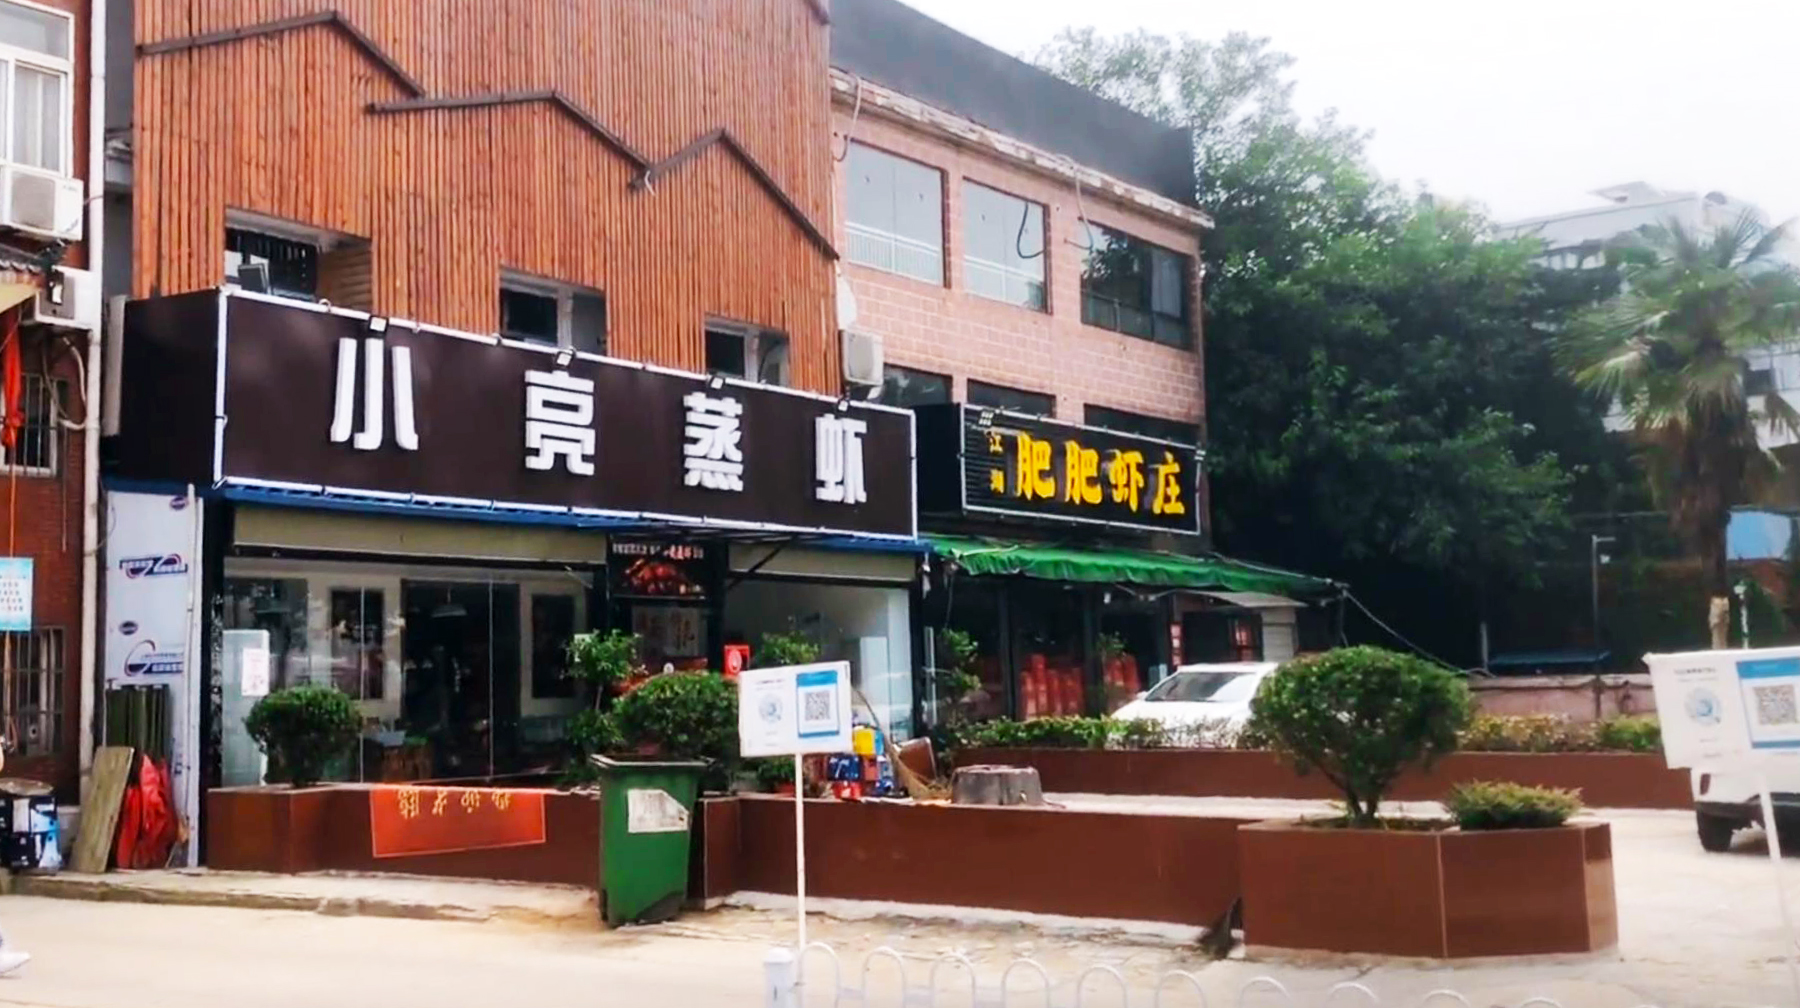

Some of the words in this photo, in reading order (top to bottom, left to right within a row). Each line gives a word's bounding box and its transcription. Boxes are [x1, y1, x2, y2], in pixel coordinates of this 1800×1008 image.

[330, 337, 867, 504] 小亮蒸虾
[1016, 430, 1185, 516] 肥肥虾庄
